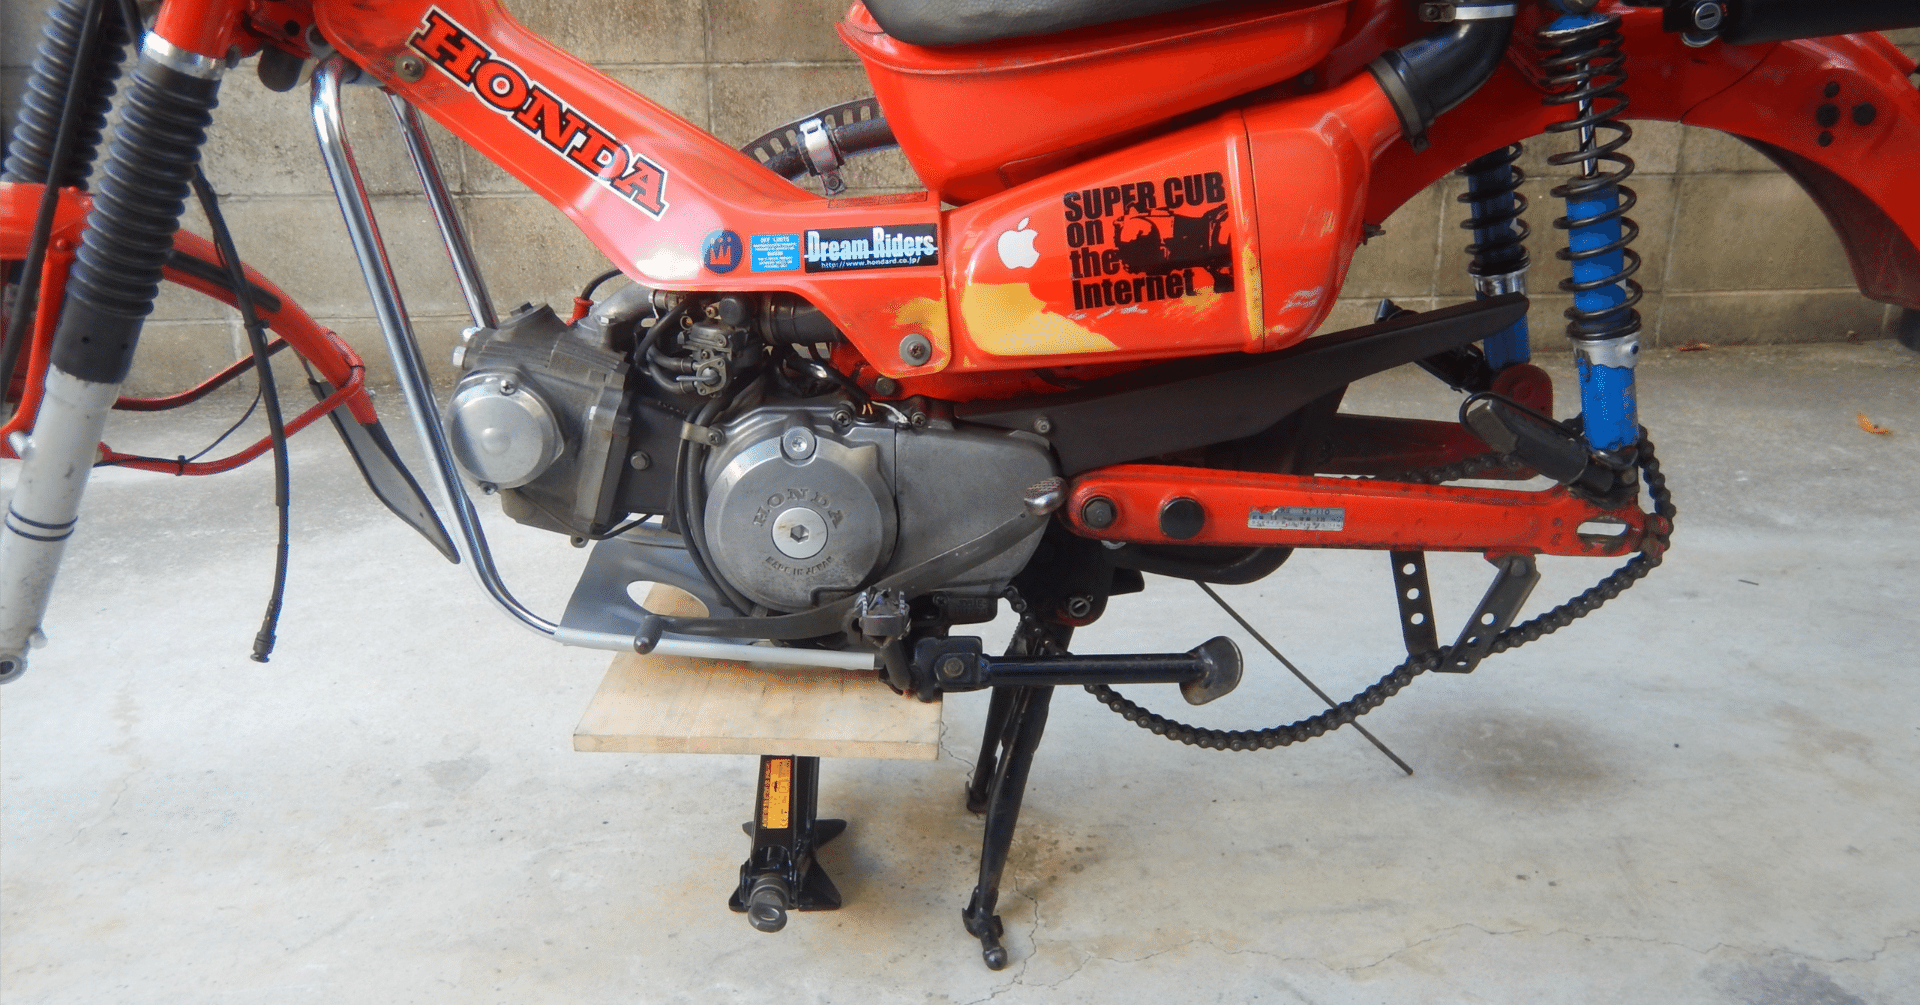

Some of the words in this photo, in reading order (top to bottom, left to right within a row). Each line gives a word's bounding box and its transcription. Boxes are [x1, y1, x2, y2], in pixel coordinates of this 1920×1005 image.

[408, 8, 666, 219] HONDA
[1063, 181, 1156, 222] SUPER
[1163, 171, 1226, 209] CUB
[807, 230, 870, 262] Dream
[872, 227, 935, 258] Riders
[1066, 219, 1105, 248] on
[820, 256, 921, 269] http://www.hondard.co.jp/
[1069, 246, 1121, 279] the
[1071, 268, 1197, 311] Internet
[753, 488, 844, 529] HONDA
[765, 556, 790, 574] MADE
[805, 555, 833, 575] JAPAN
